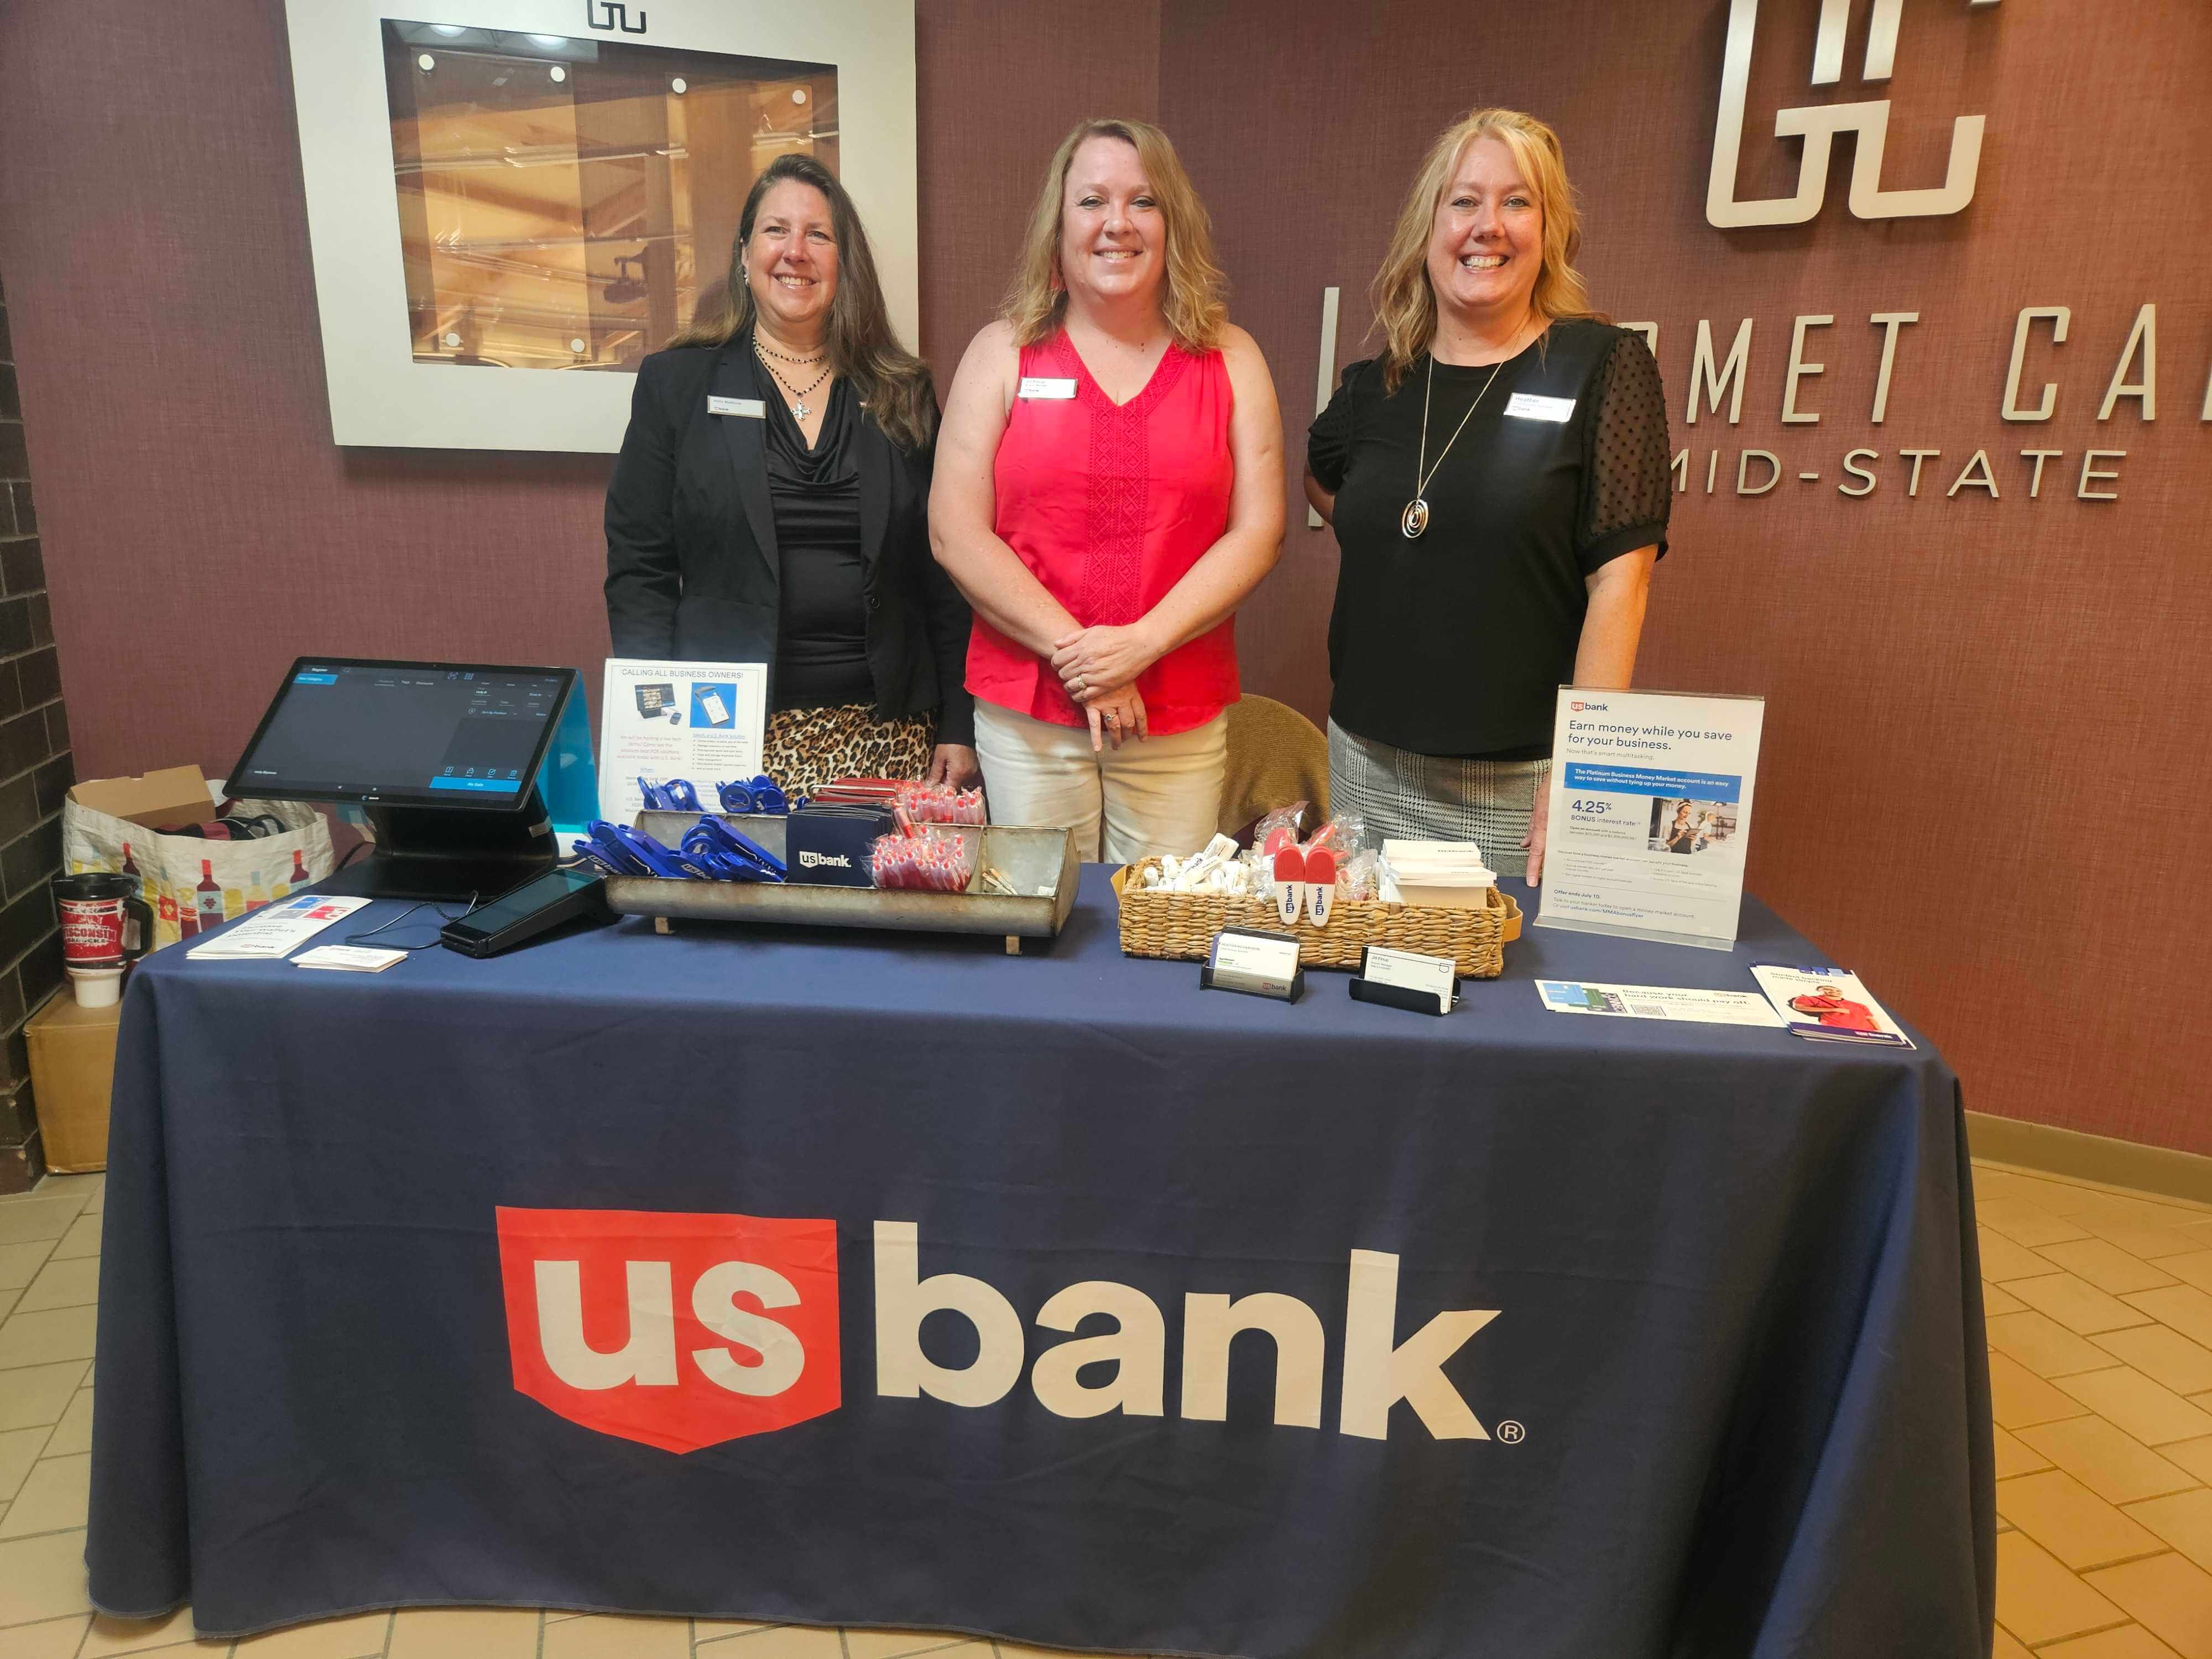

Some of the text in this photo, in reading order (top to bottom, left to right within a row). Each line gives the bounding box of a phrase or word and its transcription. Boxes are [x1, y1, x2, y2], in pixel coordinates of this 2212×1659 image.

[2001, 304, 2212, 420] CA
[708, 671, 744, 679] OWNERS!
[1585, 702, 1608, 712] bank
[1569, 720, 1733, 741] Earn money while you save
[1568, 733, 1672, 750] for your business.
[1616, 752, 1655, 761] multitasking.
[1629, 779, 1643, 787] tying
[1572, 799, 1612, 814] 4.25%
[1571, 815, 1596, 823] BONUS
[1597, 816, 1621, 825] interest
[533, 1259, 806, 1396] us
[874, 1220, 1503, 1441] bank
